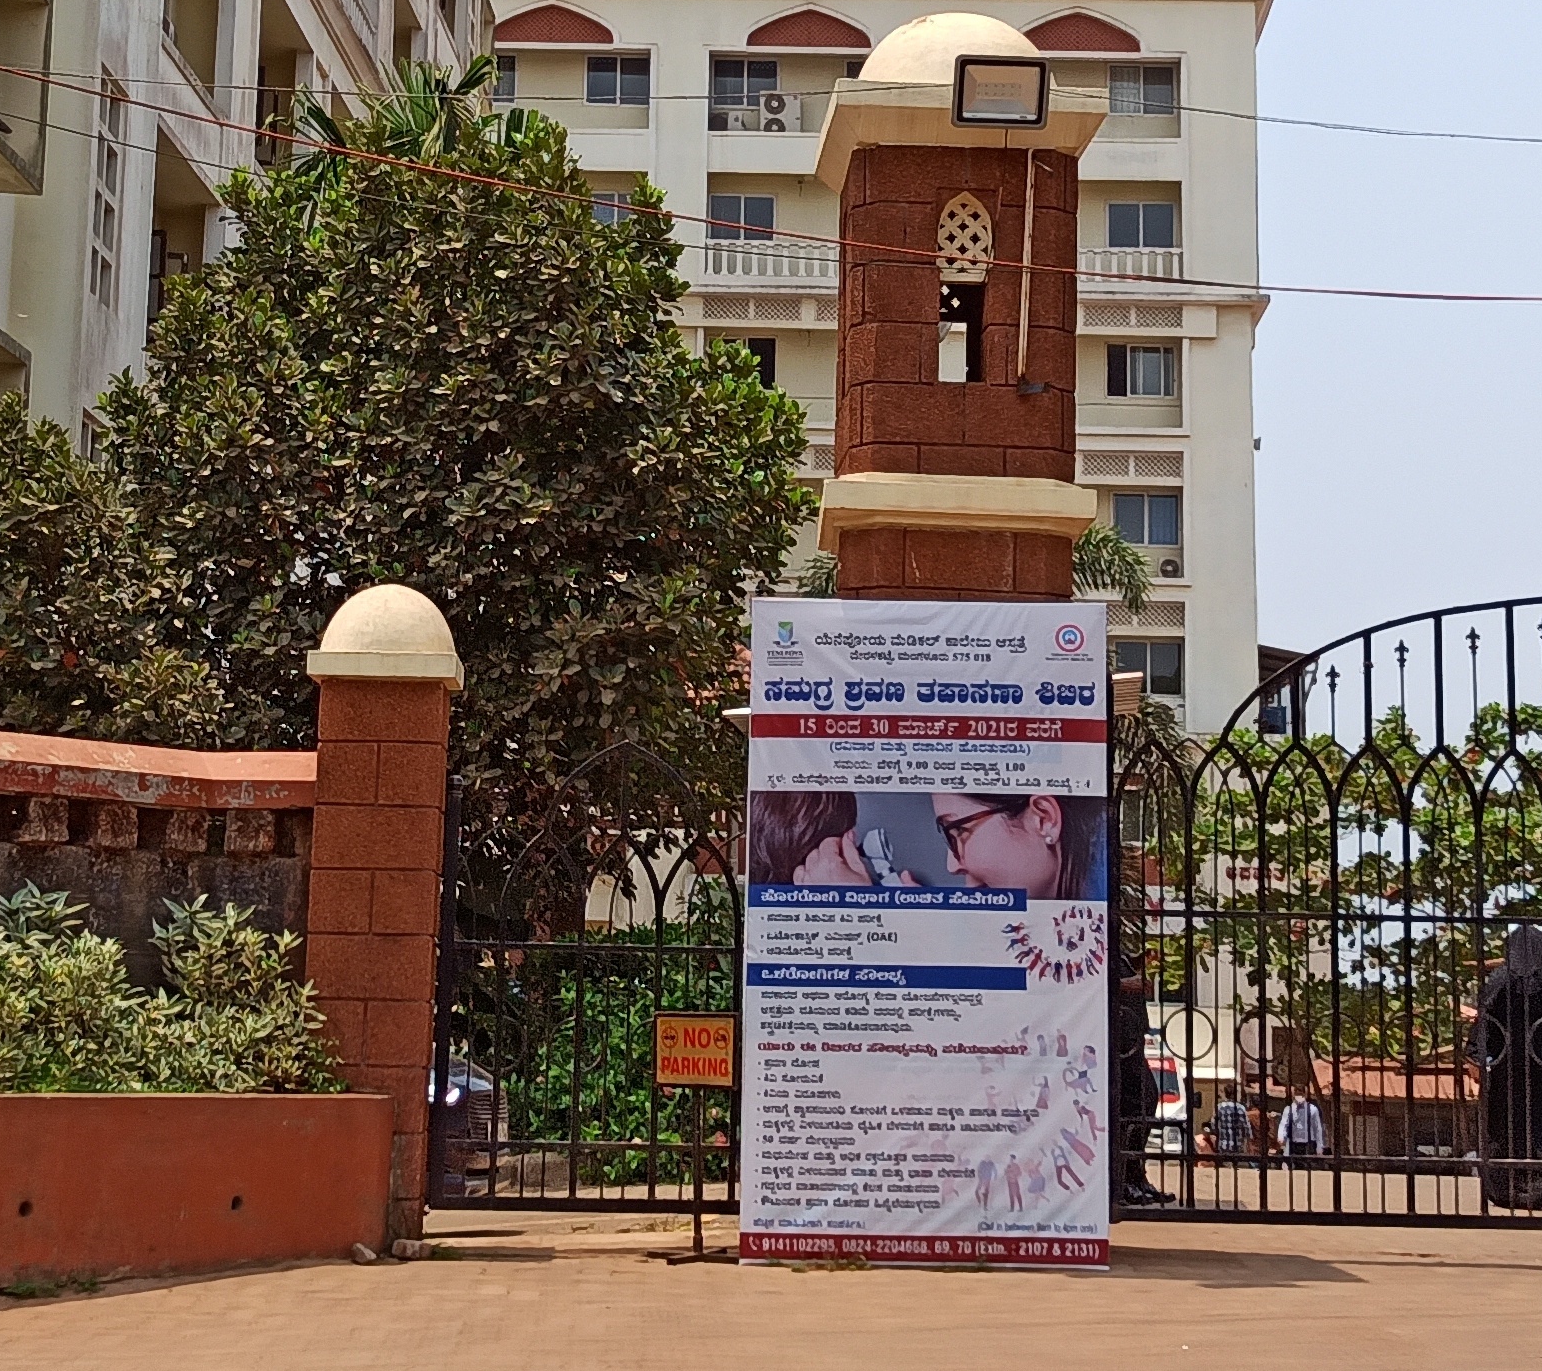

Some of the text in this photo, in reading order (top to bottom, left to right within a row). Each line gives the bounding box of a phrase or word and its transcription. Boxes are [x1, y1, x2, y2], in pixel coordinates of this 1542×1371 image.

[891, 634, 940, 647] ಮೆಡಿಕಲ್
[946, 636, 991, 648] ಕಾಲೇಜು
[996, 635, 1027, 654] ಆಸ್ಪತ್ರೆ
[952, 652, 971, 662] 575
[973, 653, 991, 663] 018
[764, 677, 1096, 711] ಸಮಗ್ರ ಶ್ರವಣ ತಪಾಸಣಾ ಶಿಬಿರ
[799, 718, 1063, 739] 15 ರಿಂದ 30 ಮಾರ್ಚ್ 2021ರ ವರೆಗೆ
[881, 741, 908, 756] ಮತ್ತು
[906, 760, 929, 771] 9.00
[933, 761, 956, 771] ರಿಂದ
[760, 889, 1015, 906] ಹೊರರೋಗಿ ವಿಭಾಗ (ಉಚಿತ ಸೇವೆಗಳು)
[866, 932, 898, 944] (OAE)
[761, 967, 907, 985] ಒಳರೋಗಿಗಳ ಸೌಲಭ್ಯ
[684, 1027, 711, 1049] NO
[660, 1056, 729, 1077] PARKING
[957, 1241, 971, 1254] 70
[1019, 1242, 1049, 1255] 2107
[1052, 1243, 1061, 1256] &
[1065, 1243, 1100, 1259] 2131)
